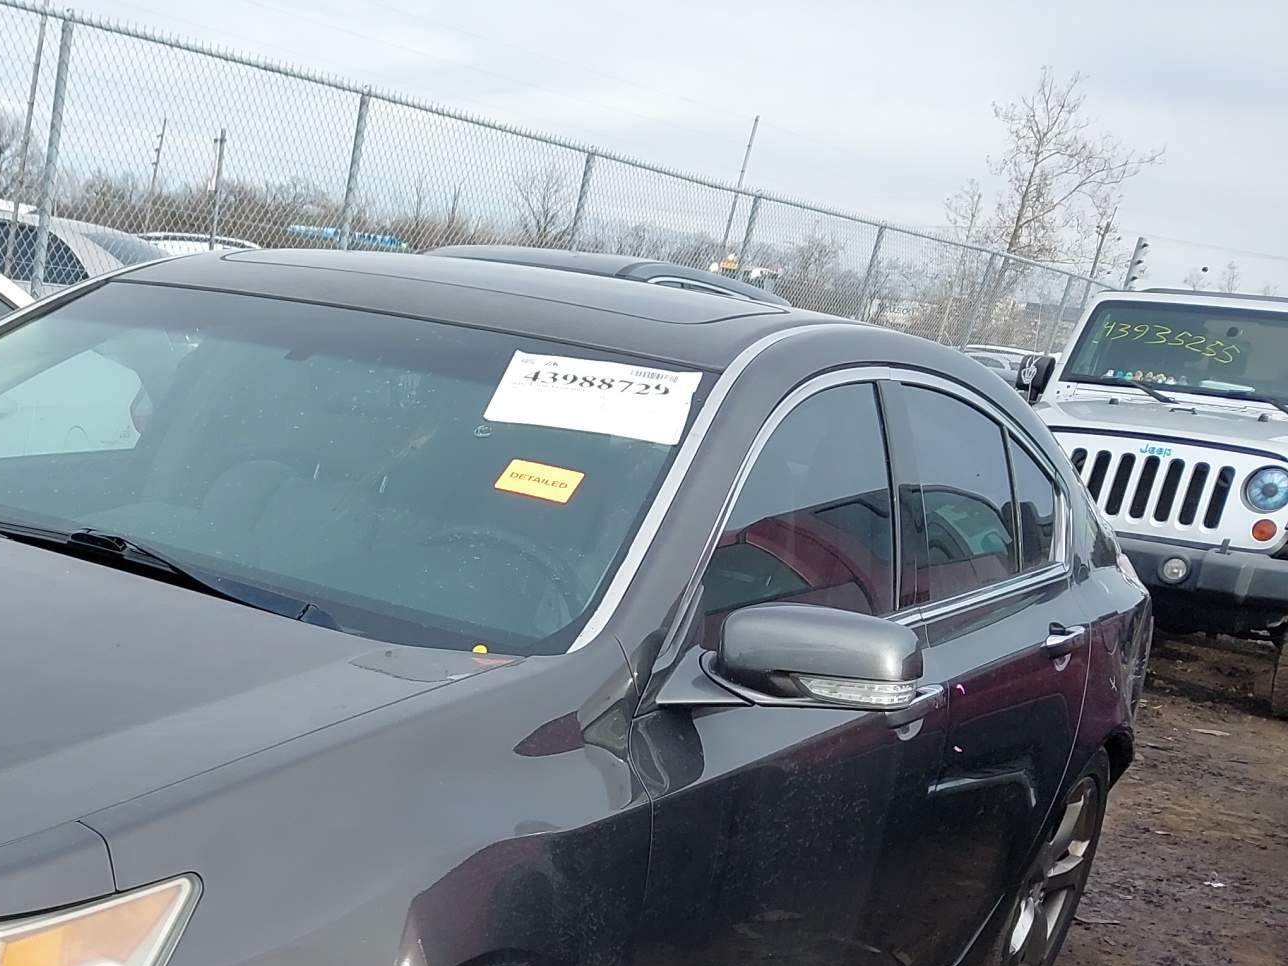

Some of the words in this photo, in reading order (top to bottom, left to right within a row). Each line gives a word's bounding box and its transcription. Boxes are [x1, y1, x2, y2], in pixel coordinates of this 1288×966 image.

[1103, 321, 1240, 364] 43935255
[524, 369, 670, 396] 43988729
[1139, 443, 1172, 458] Jeep
[509, 471, 568, 489] DETAILED
